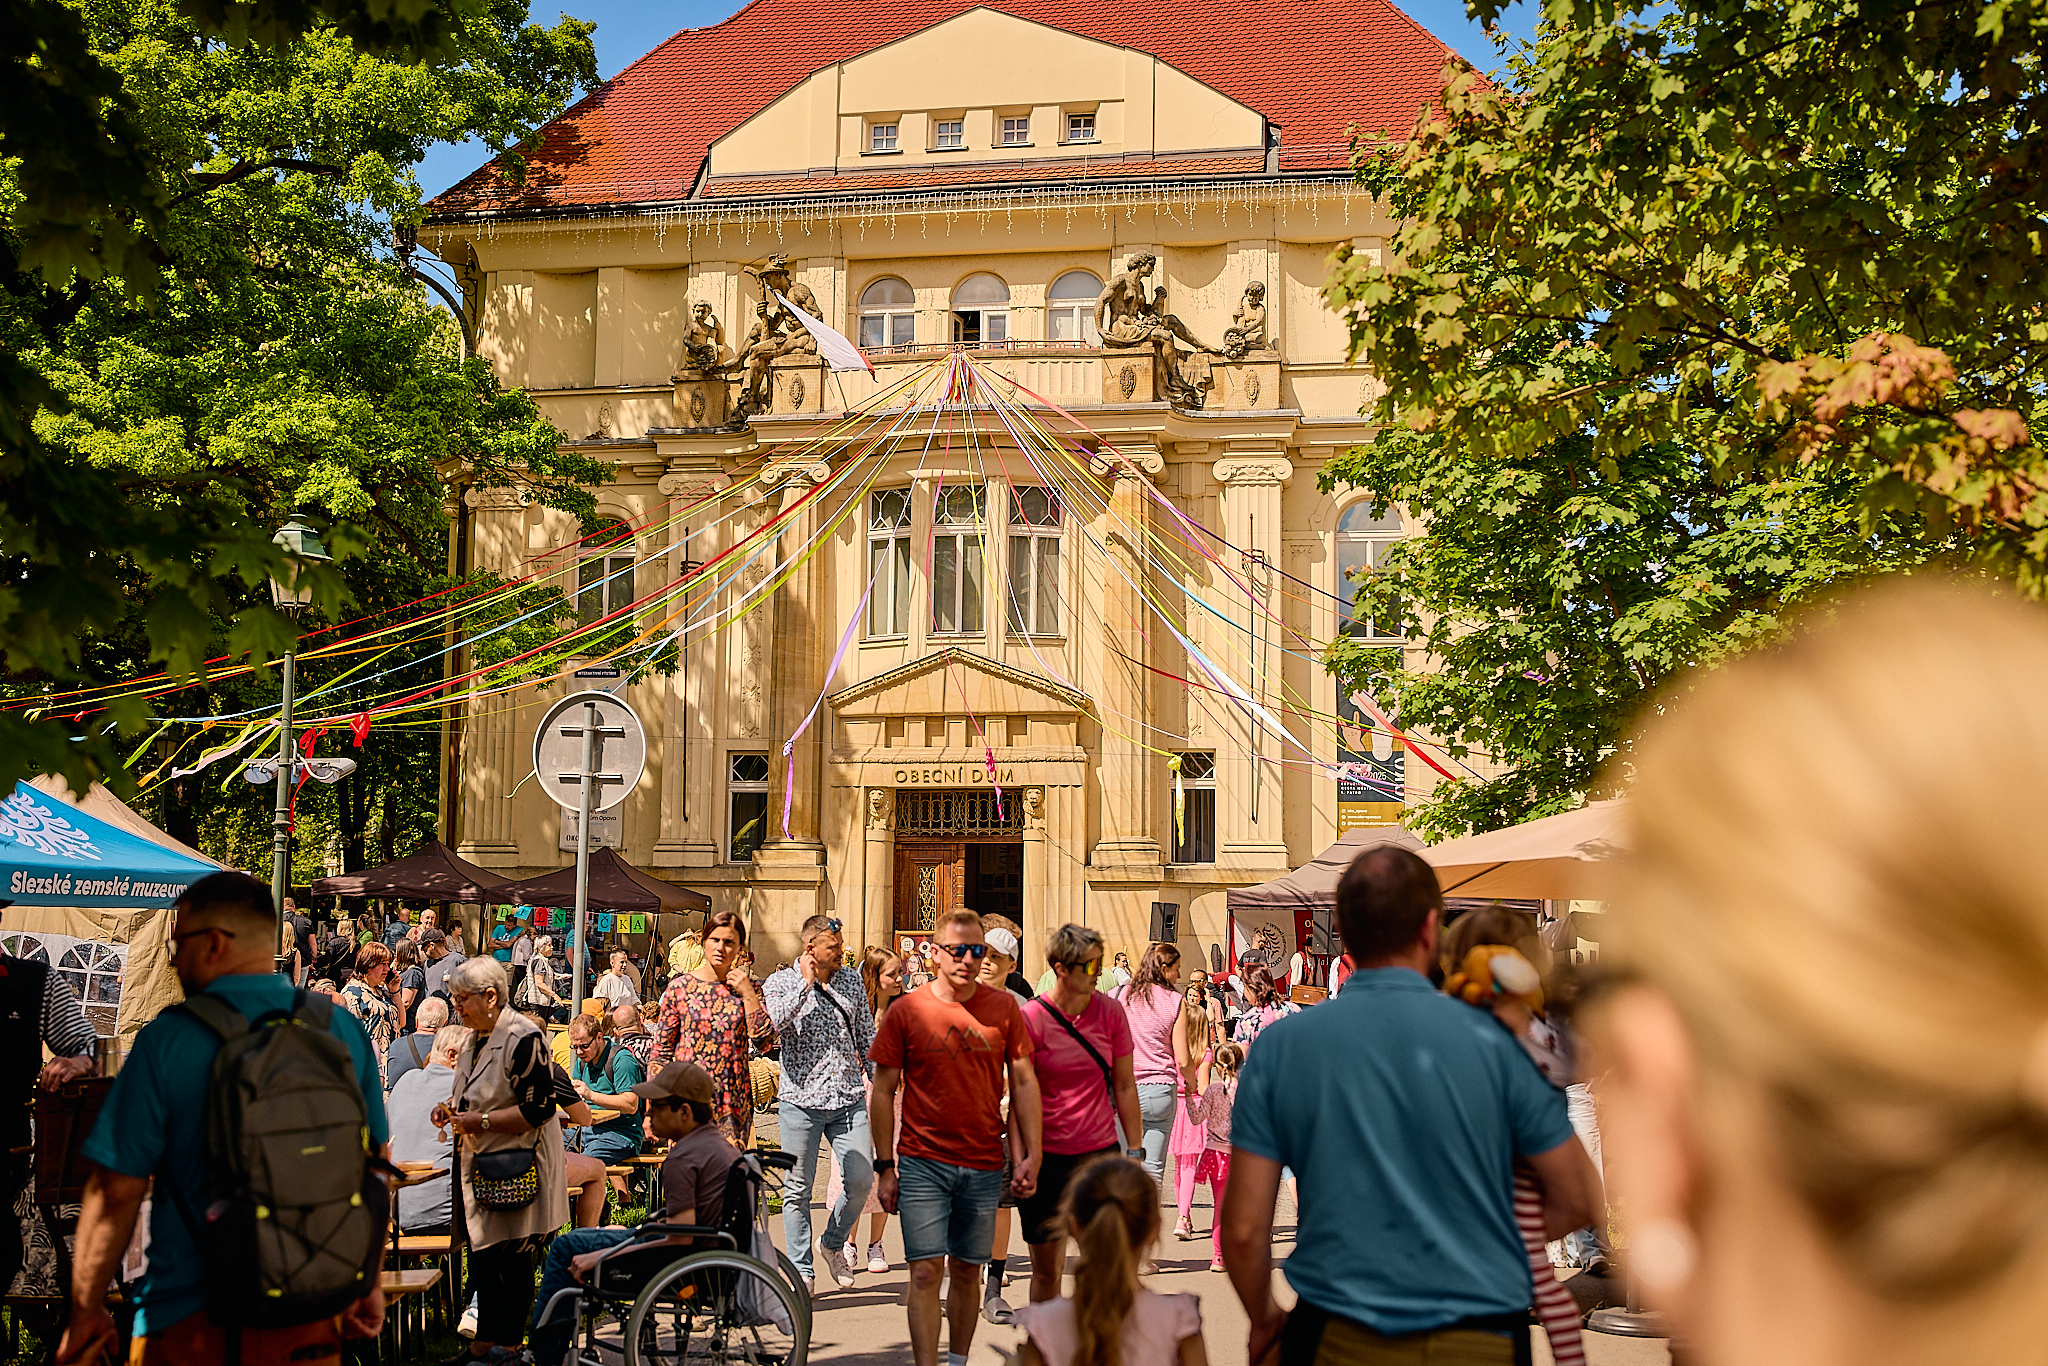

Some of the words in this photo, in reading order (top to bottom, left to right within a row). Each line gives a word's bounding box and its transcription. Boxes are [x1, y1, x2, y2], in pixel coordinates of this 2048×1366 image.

[894, 766, 963, 784] OBECNÍ
[10, 870, 72, 895] Slezské
[73, 876, 131, 897] zemské
[130, 881, 188, 899] muzeum
